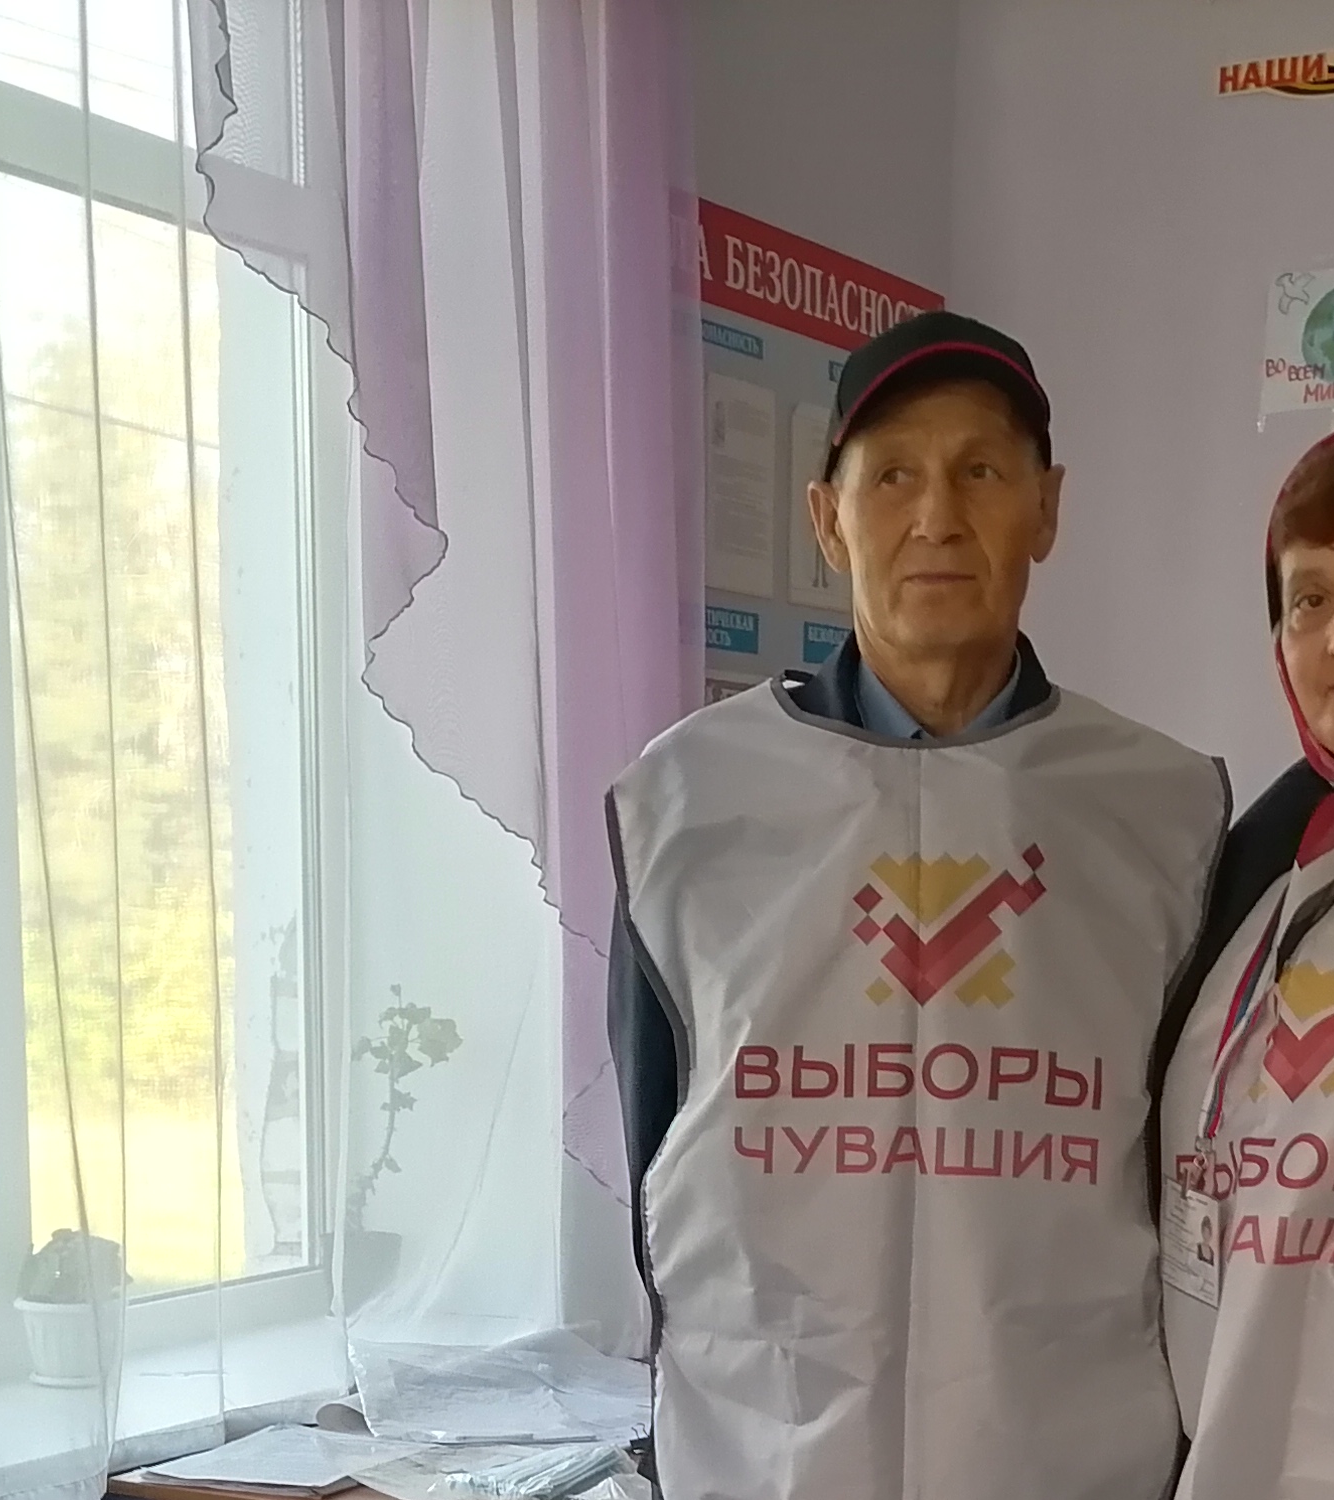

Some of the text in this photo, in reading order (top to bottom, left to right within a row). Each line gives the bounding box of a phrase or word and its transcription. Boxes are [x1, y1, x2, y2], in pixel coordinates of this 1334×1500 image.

[1219, 54, 1325, 94] НАШИ
[1265, 357, 1326, 382] ВО ВСЕМ
[734, 1043, 1102, 1111] ВЫБОРЫ
[734, 1126, 1099, 1185] ЧУВАШИЯ
